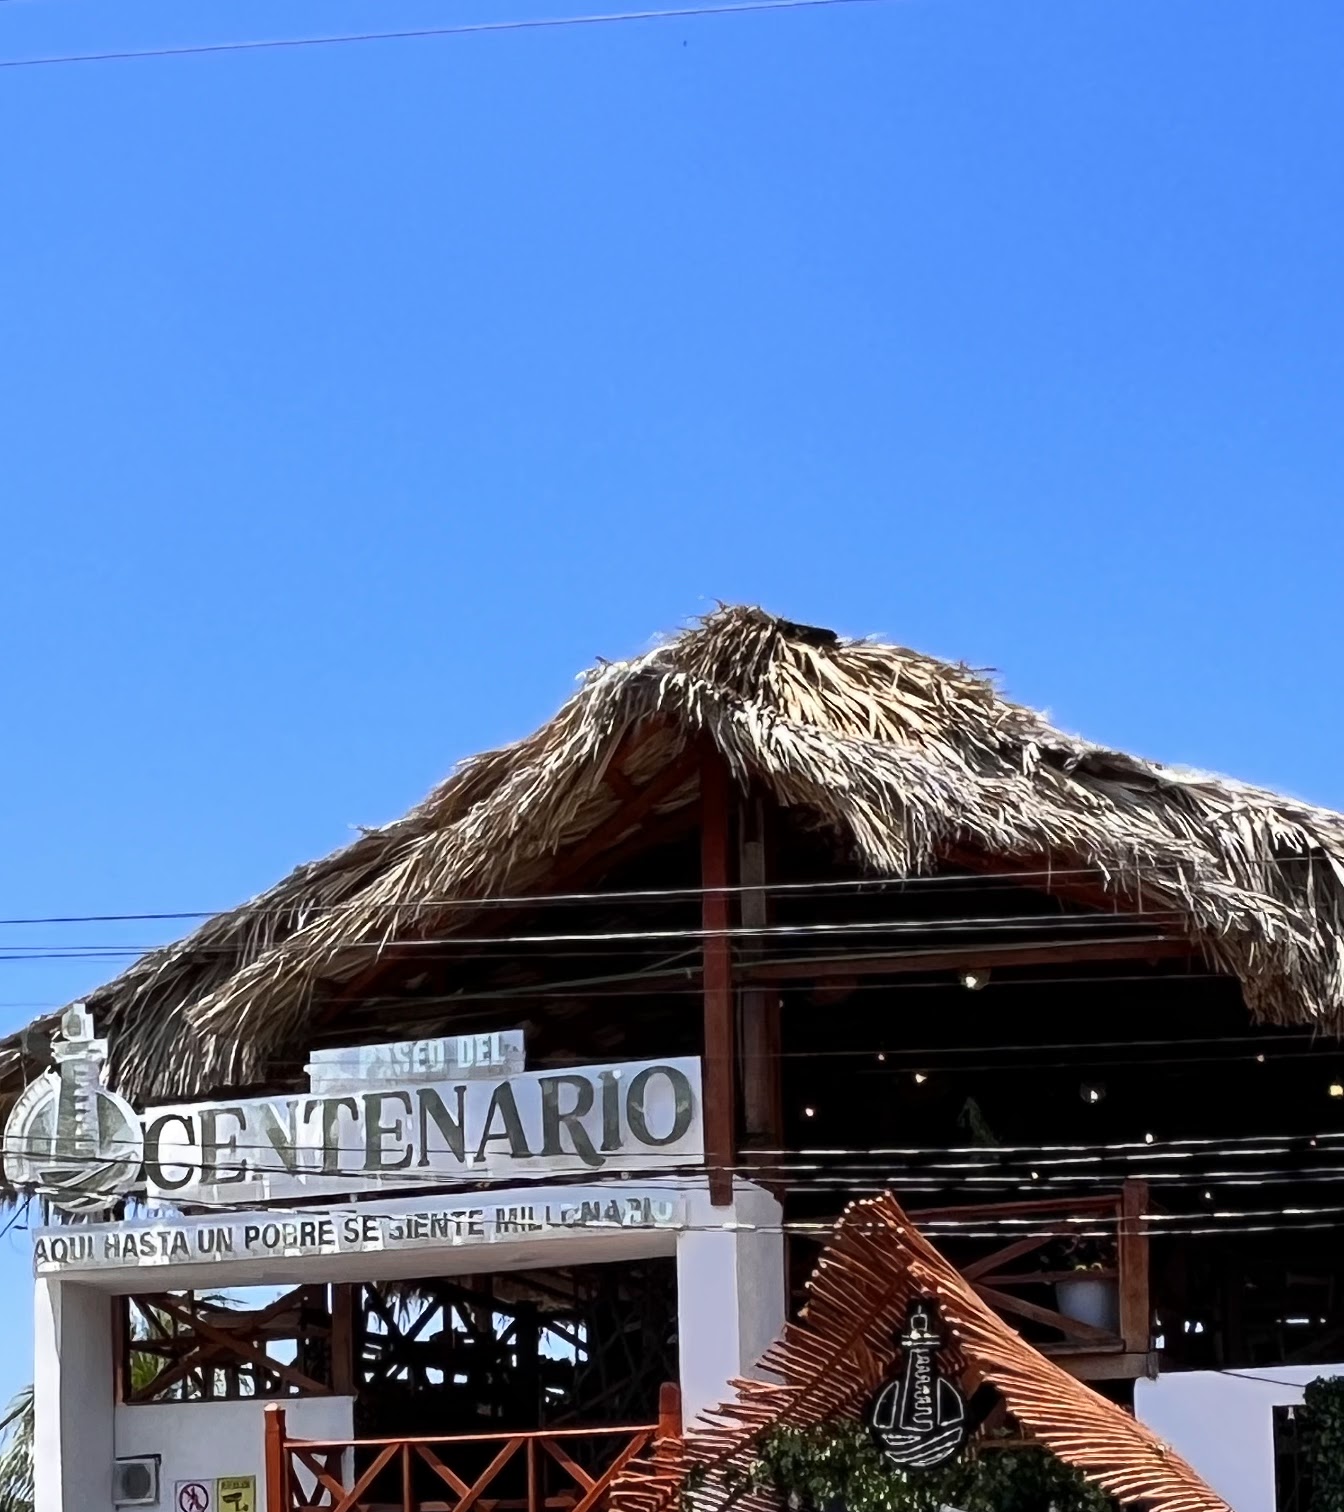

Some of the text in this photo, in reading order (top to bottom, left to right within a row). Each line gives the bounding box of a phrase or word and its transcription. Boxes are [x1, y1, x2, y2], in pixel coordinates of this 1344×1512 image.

[457, 1032, 506, 1069] DEL
[143, 1064, 693, 1190] CENTENARIO
[35, 1235, 94, 1264] AQUI
[105, 1230, 190, 1259] HASTA
[198, 1226, 233, 1254] UN
[244, 1219, 336, 1250] POBRE
[343, 1215, 380, 1243] SE
[388, 1208, 485, 1240] SIENTE
